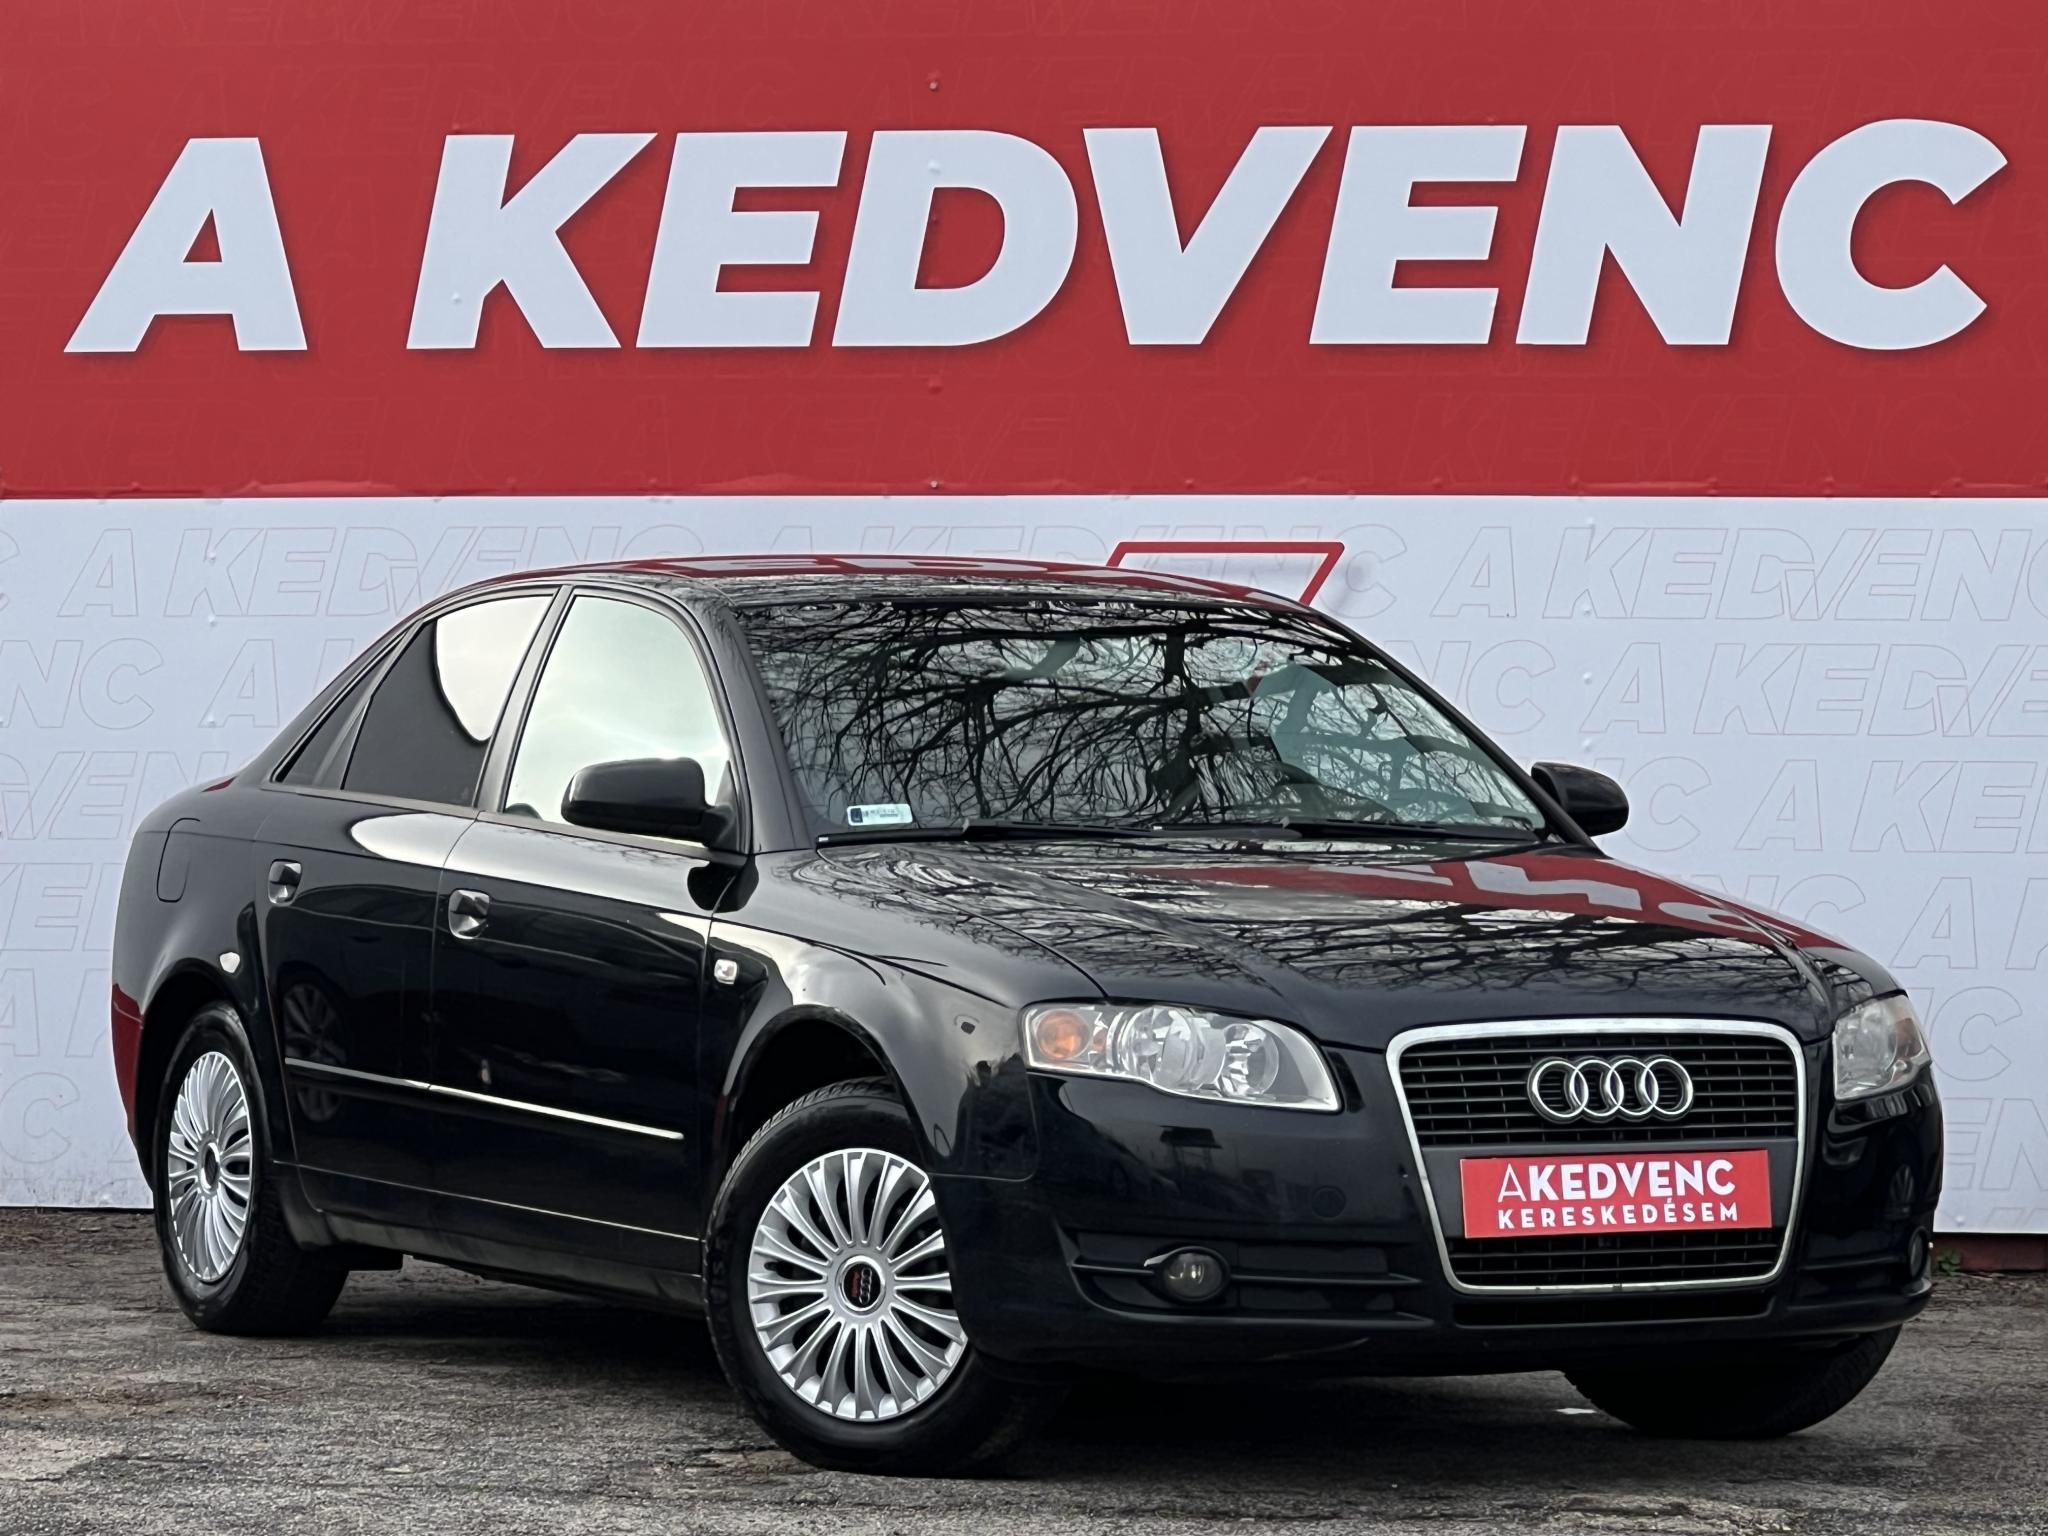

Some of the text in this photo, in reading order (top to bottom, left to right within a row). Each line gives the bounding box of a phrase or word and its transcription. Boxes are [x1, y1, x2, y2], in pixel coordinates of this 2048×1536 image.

[64, 137, 308, 353] A
[406, 118, 2008, 351] KEDVENC
[56, 527, 139, 618] A
[1430, 526, 1518, 619] A
[1542, 526, 2048, 621] KEDVEN
[198, 638, 281, 729] A
[1579, 642, 1667, 735] A
[1734, 758, 1824, 852] A
[1891, 876, 1979, 969] A
[1498, 1198, 1739, 1230] KERESKEDÉSEM
